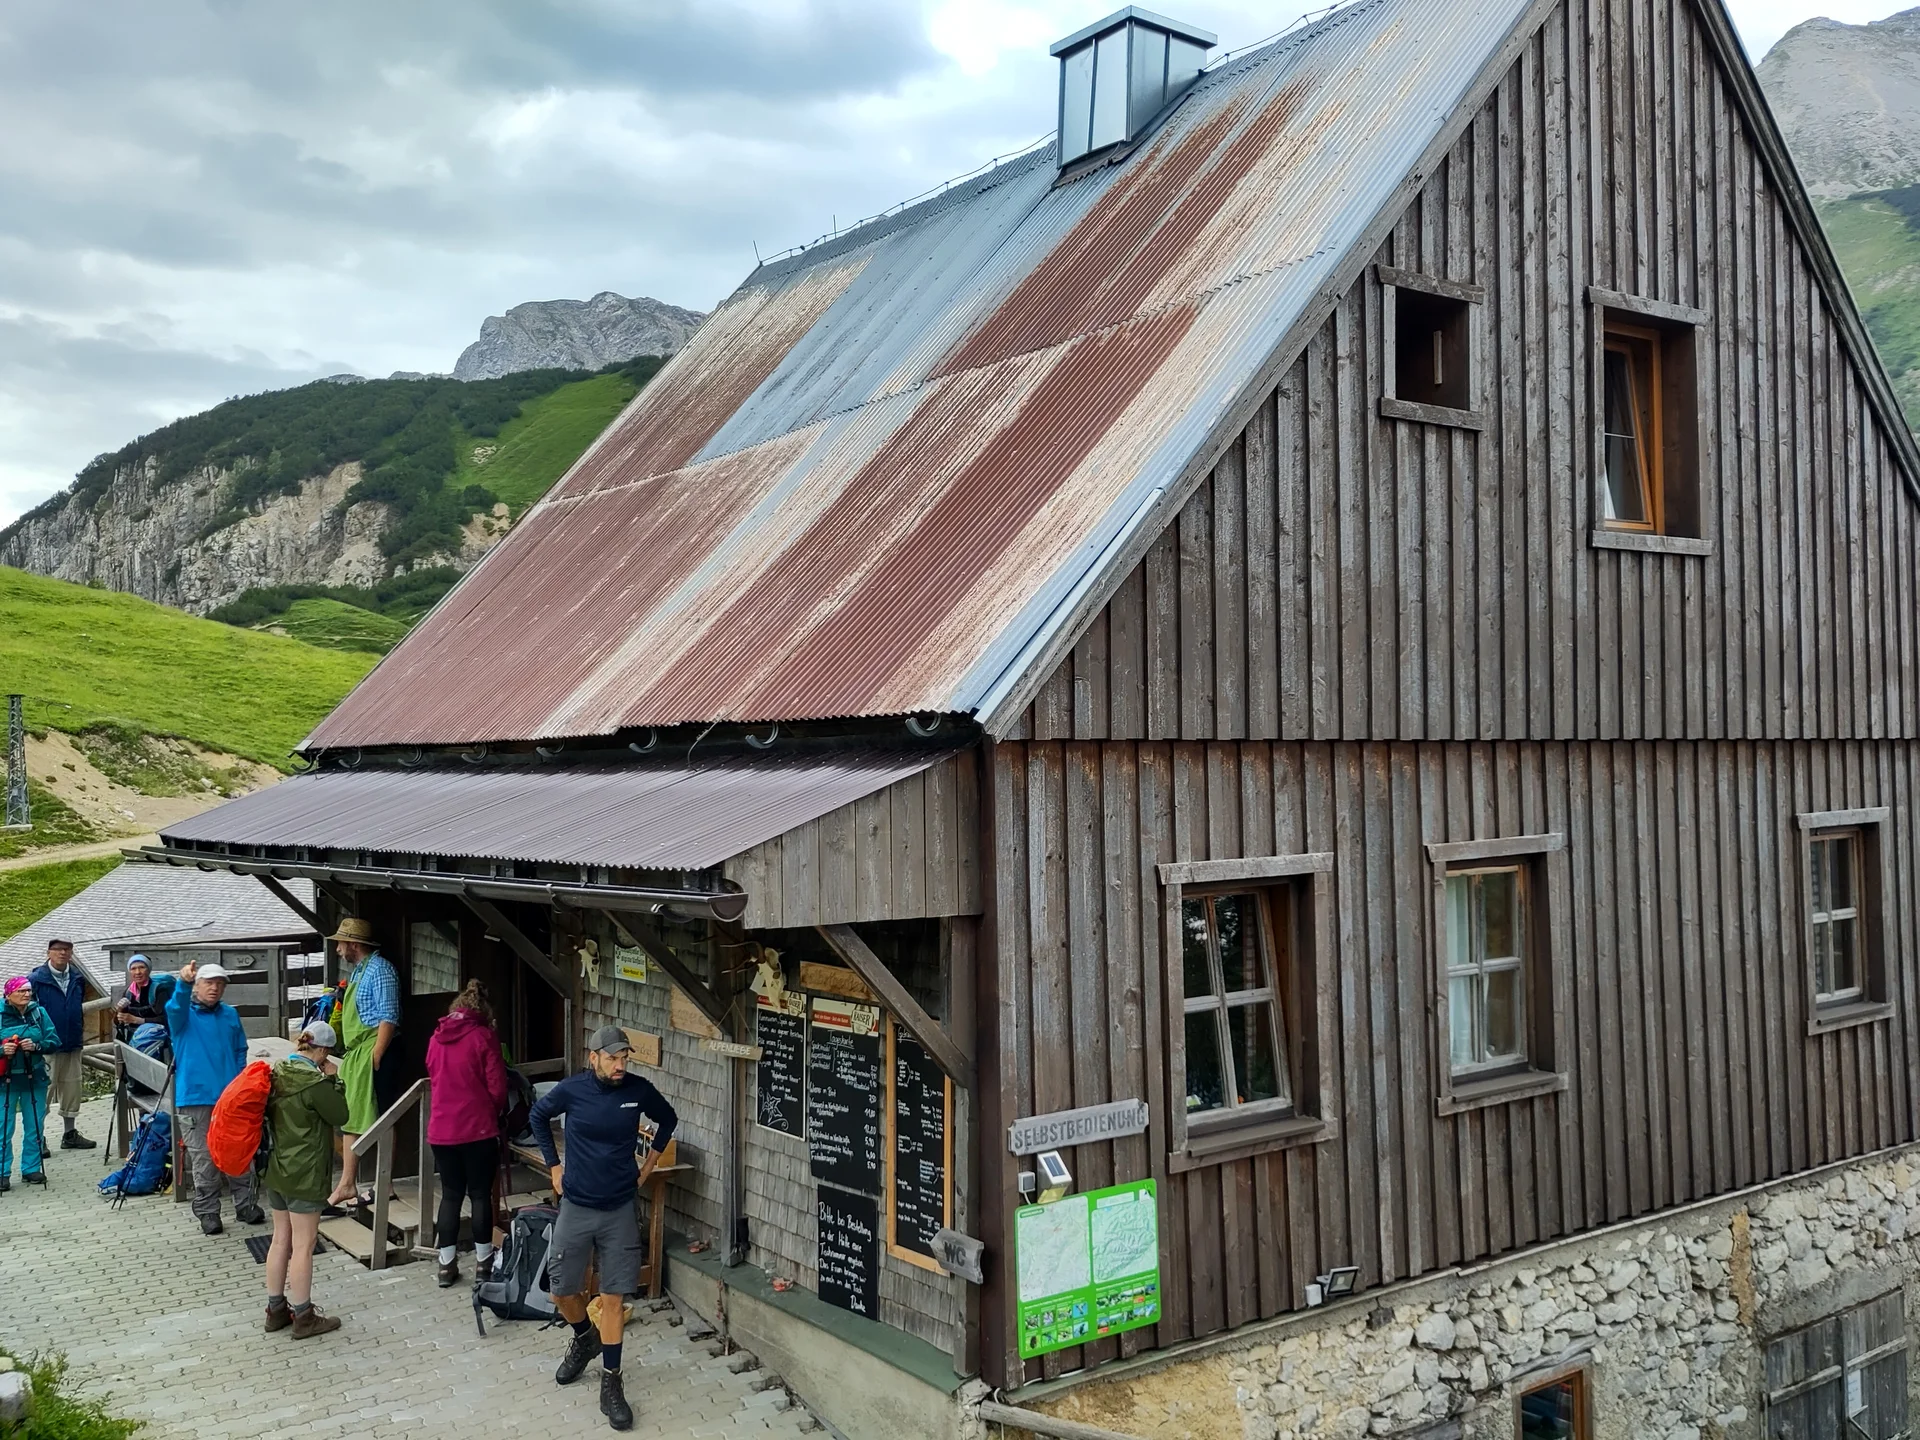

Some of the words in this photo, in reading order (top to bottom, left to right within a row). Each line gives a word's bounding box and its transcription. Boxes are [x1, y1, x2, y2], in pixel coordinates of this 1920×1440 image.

[853, 1011, 871, 1026] KAISER
[708, 1040, 751, 1056] ALPENLIEBE
[827, 1029, 854, 1050] Tageskarte
[1014, 1107, 1145, 1149] SELBSTBEDIENUNG
[819, 1201, 835, 1225] Bitte
[837, 1208, 845, 1226] bei
[847, 1213, 872, 1242] Bestellung
[943, 1241, 966, 1267] WC
[819, 1257, 829, 1270] Das
[830, 1261, 843, 1274] Essen
[844, 1266, 859, 1283] bringen
[850, 1294, 867, 1313] Danke
